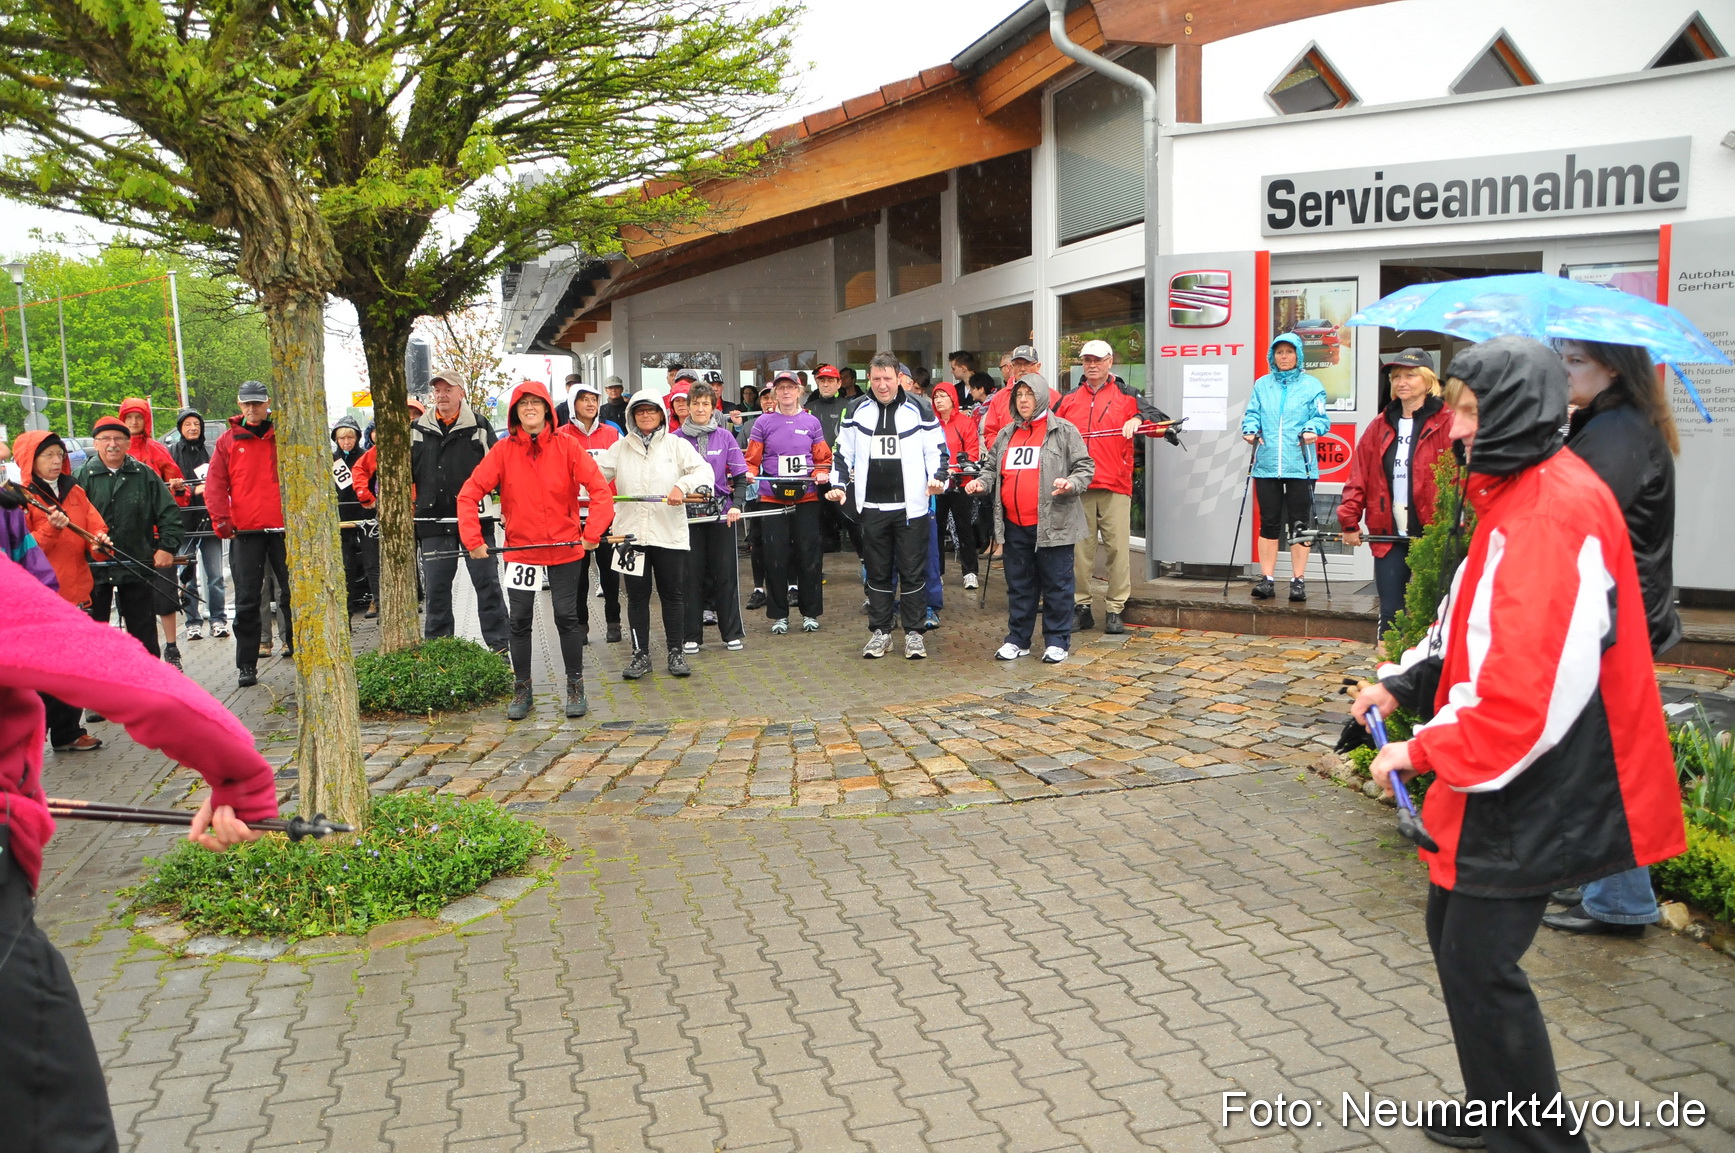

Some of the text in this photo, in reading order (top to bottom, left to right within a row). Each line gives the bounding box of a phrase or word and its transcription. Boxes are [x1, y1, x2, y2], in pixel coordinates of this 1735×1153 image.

[1266, 153, 1681, 231] Serviceannahme
[1678, 281, 1735, 292] Gerhart
[1160, 343, 1245, 358] SEAT
[880, 436, 897, 456] 19
[1013, 447, 1034, 465] 20
[333, 465, 351, 483] 36
[784, 488, 796, 497] CAT
[513, 565, 536, 587] 38
